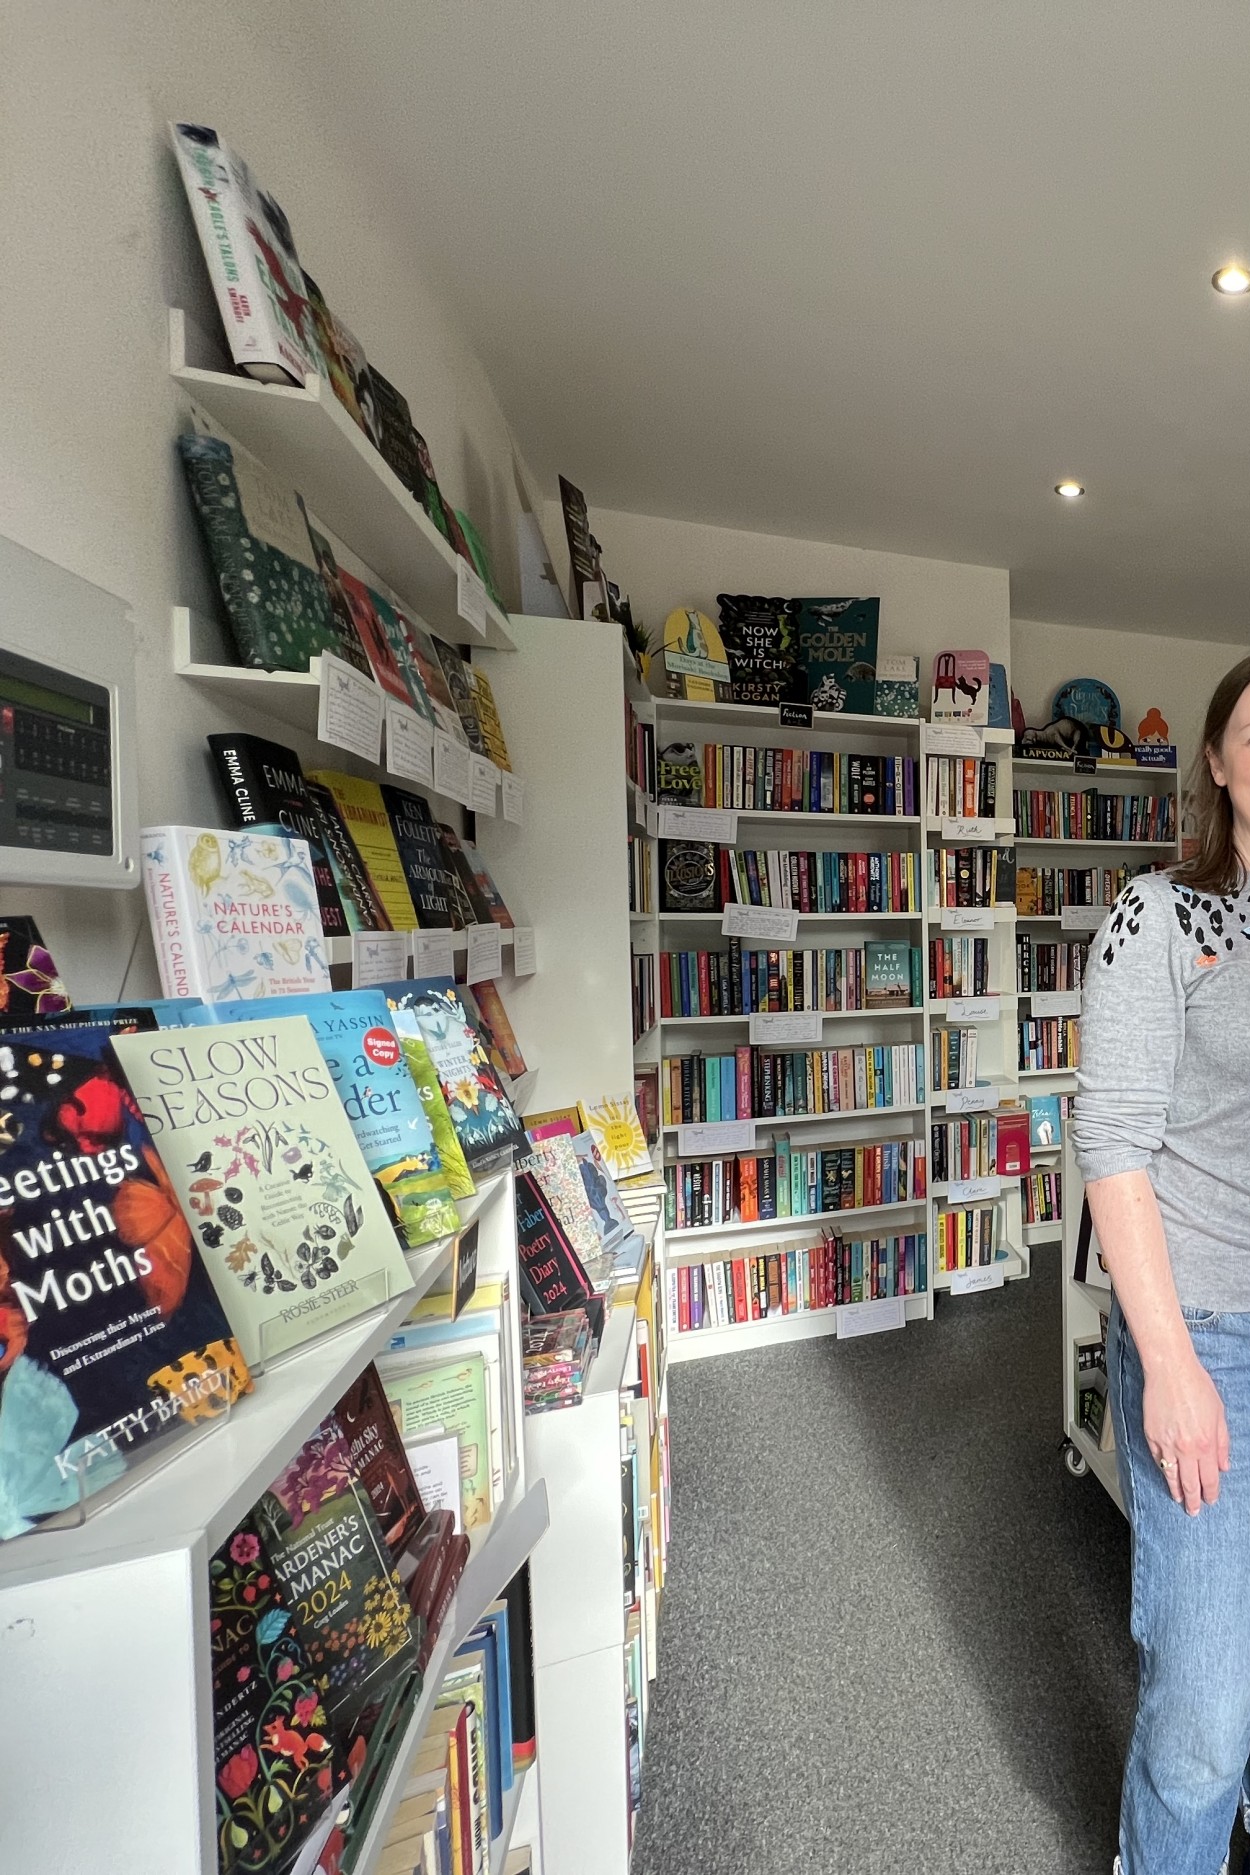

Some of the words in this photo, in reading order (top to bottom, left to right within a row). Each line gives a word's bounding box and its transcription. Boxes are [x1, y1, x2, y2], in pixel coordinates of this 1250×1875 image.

[742, 626, 778, 636] NOW
[801, 632, 867, 648] GOLDEN
[746, 637, 773, 648] SHE
[753, 648, 765, 657] IS
[808, 648, 856, 663] MOLE
[732, 682, 781, 693] KIRSTY
[733, 691, 781, 702] LOGAN
[1023, 749, 1070, 760] LAPVONA
[660, 760, 700, 776] Free
[850, 760, 861, 779] WOLF
[224, 749, 245, 786] EMMA
[235, 788, 257, 823] CLINE
[263, 764, 306, 798] EMMA
[659, 775, 702, 790] Love
[403, 800, 424, 821] KEN
[278, 809, 320, 839] CLINE
[956, 823, 983, 837] Ruth
[158, 871, 181, 938] NATURE'S
[213, 901, 293, 918] NATURE'S
[419, 894, 449, 912] LIGHT
[216, 921, 305, 935] CALENDAR
[874, 962, 901, 971] HALF
[877, 953, 898, 961] THE
[871, 973, 904, 981] MOON
[12, 1025, 35, 1034] THE
[36, 1023, 58, 1032] NAN
[59, 1020, 111, 1031] SHEPHERD
[112, 1018, 139, 1026] PRIZE
[324, 1014, 385, 1033] YASSIN
[367, 1037, 396, 1048] Signed
[150, 1035, 279, 1087] SLOW
[372, 1048, 395, 1060] Copy
[353, 1055, 375, 1078] a
[441, 1065, 472, 1078] NIGHTS
[134, 1066, 330, 1137] SEASONS
[374, 1135, 402, 1149] Started
[882, 1150, 890, 1170] hush
[0, 1143, 139, 1207] eetings
[12, 1198, 118, 1260] with
[518, 1208, 545, 1233] Faber
[519, 1232, 553, 1263] Poetry
[529, 1256, 562, 1285] Diary
[11, 1247, 153, 1324] Moths
[543, 1280, 568, 1304] 2024
[279, 1296, 321, 1324] ROSIE
[319, 1279, 360, 1306] STEER
[50, 1331, 107, 1362] Discovering
[106, 1318, 128, 1336] their
[128, 1304, 163, 1327] Mystery
[62, 1361, 83, 1377] and
[82, 1332, 144, 1368] Extraordinary
[143, 1320, 166, 1338] Lives
[53, 1407, 150, 1480] KATTY
[150, 1368, 223, 1422] BAIRD
[362, 1421, 381, 1448] Sky
[270, 1548, 286, 1565] The
[285, 1528, 317, 1555] National
[315, 1516, 335, 1536] Trust
[296, 1569, 353, 1626] 2024
